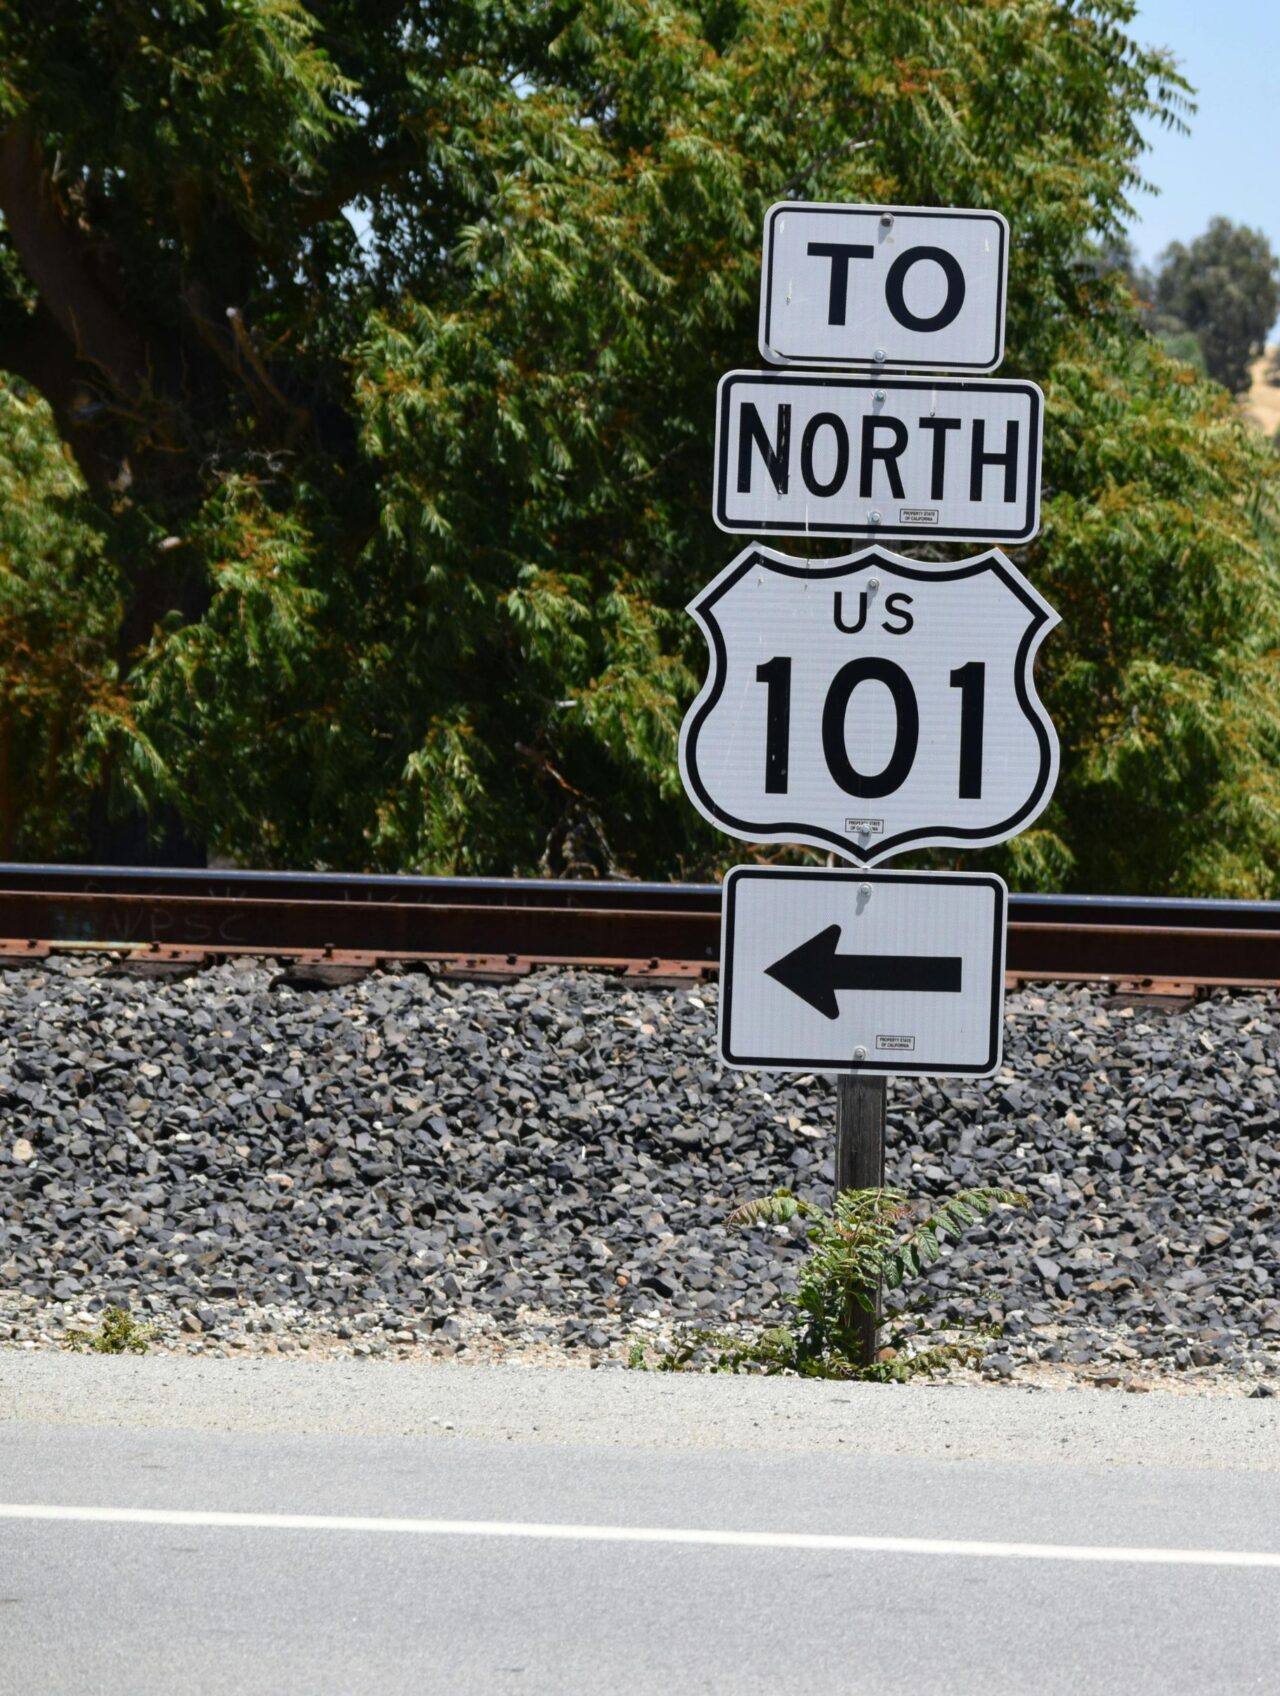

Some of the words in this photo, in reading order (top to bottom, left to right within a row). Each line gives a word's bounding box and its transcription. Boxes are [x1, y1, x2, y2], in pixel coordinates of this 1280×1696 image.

[807, 242, 966, 332] TO
[737, 402, 1020, 503] NORTH
[834, 591, 914, 635] US
[756, 656, 986, 800] 101
